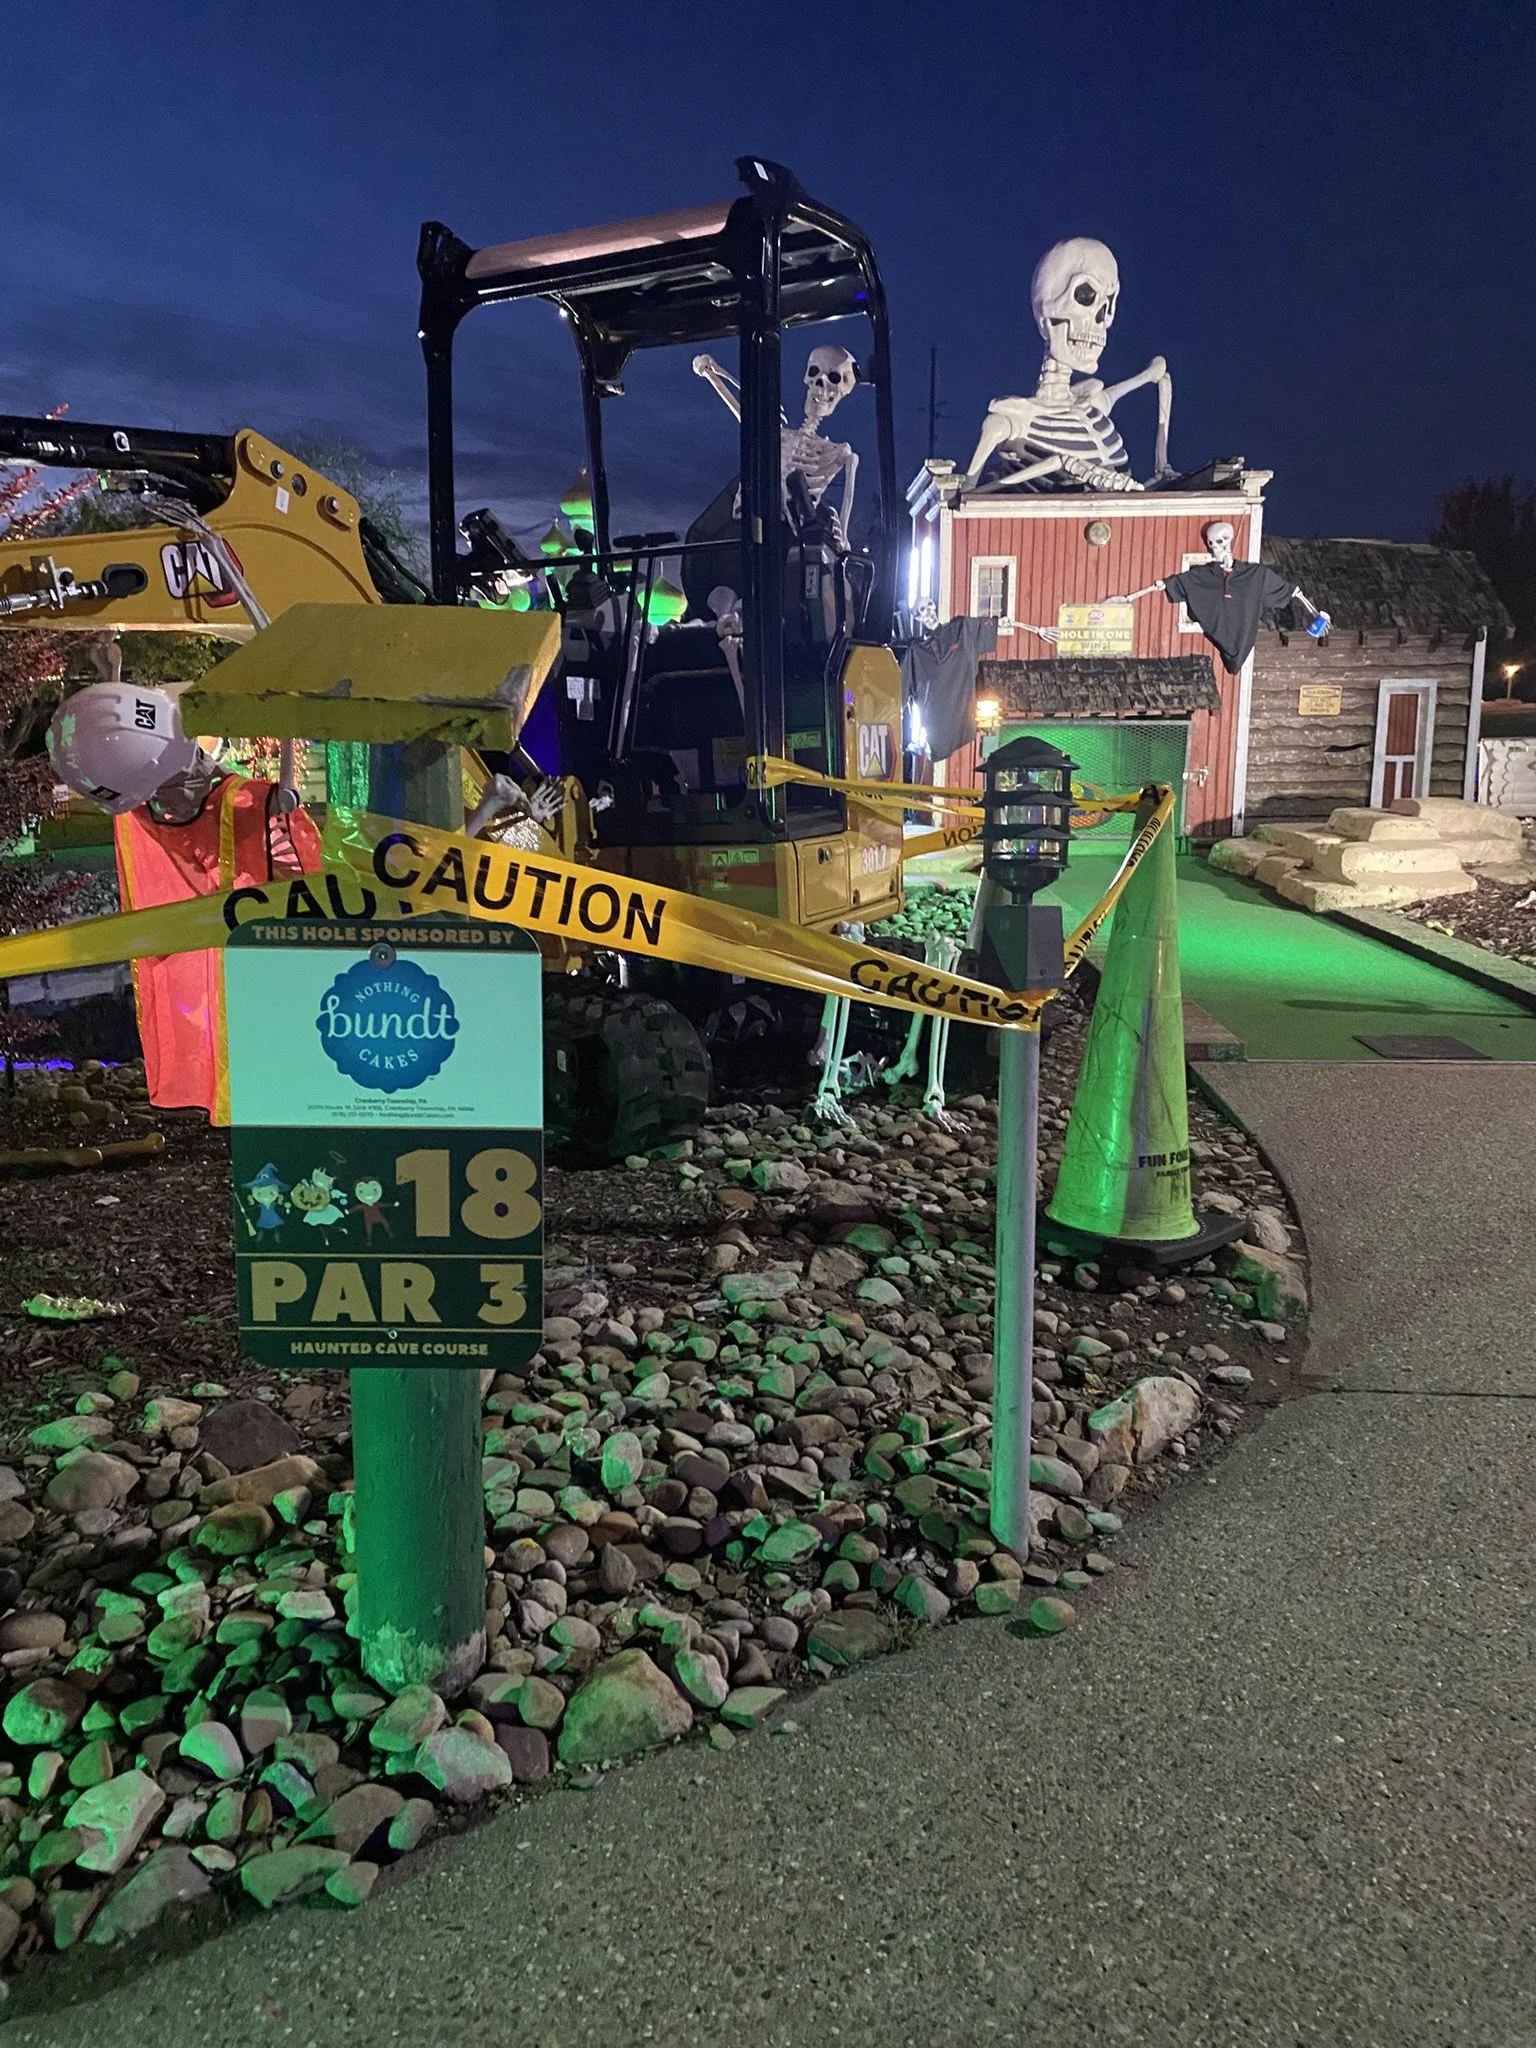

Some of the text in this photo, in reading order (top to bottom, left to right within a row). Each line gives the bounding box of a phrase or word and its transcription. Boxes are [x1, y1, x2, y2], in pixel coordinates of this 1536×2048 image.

[1060, 630, 1130, 639] HOLE IN ONE
[135, 698, 156, 730] CAT
[859, 723, 888, 777] CAT
[372, 832, 668, 946] CAUTION
[252, 925, 515, 945] THIS HOLE SPONSORED BY
[355, 981, 420, 1004] NOTHING
[320, 994, 457, 1040] bundt
[359, 1048, 420, 1070] CAKES
[1138, 1154, 1166, 1168] FUN
[395, 1148, 542, 1240] 18
[251, 1261, 528, 1325] PAR 3
[291, 1342, 488, 1356] HAUNTED CAVE COURSE
